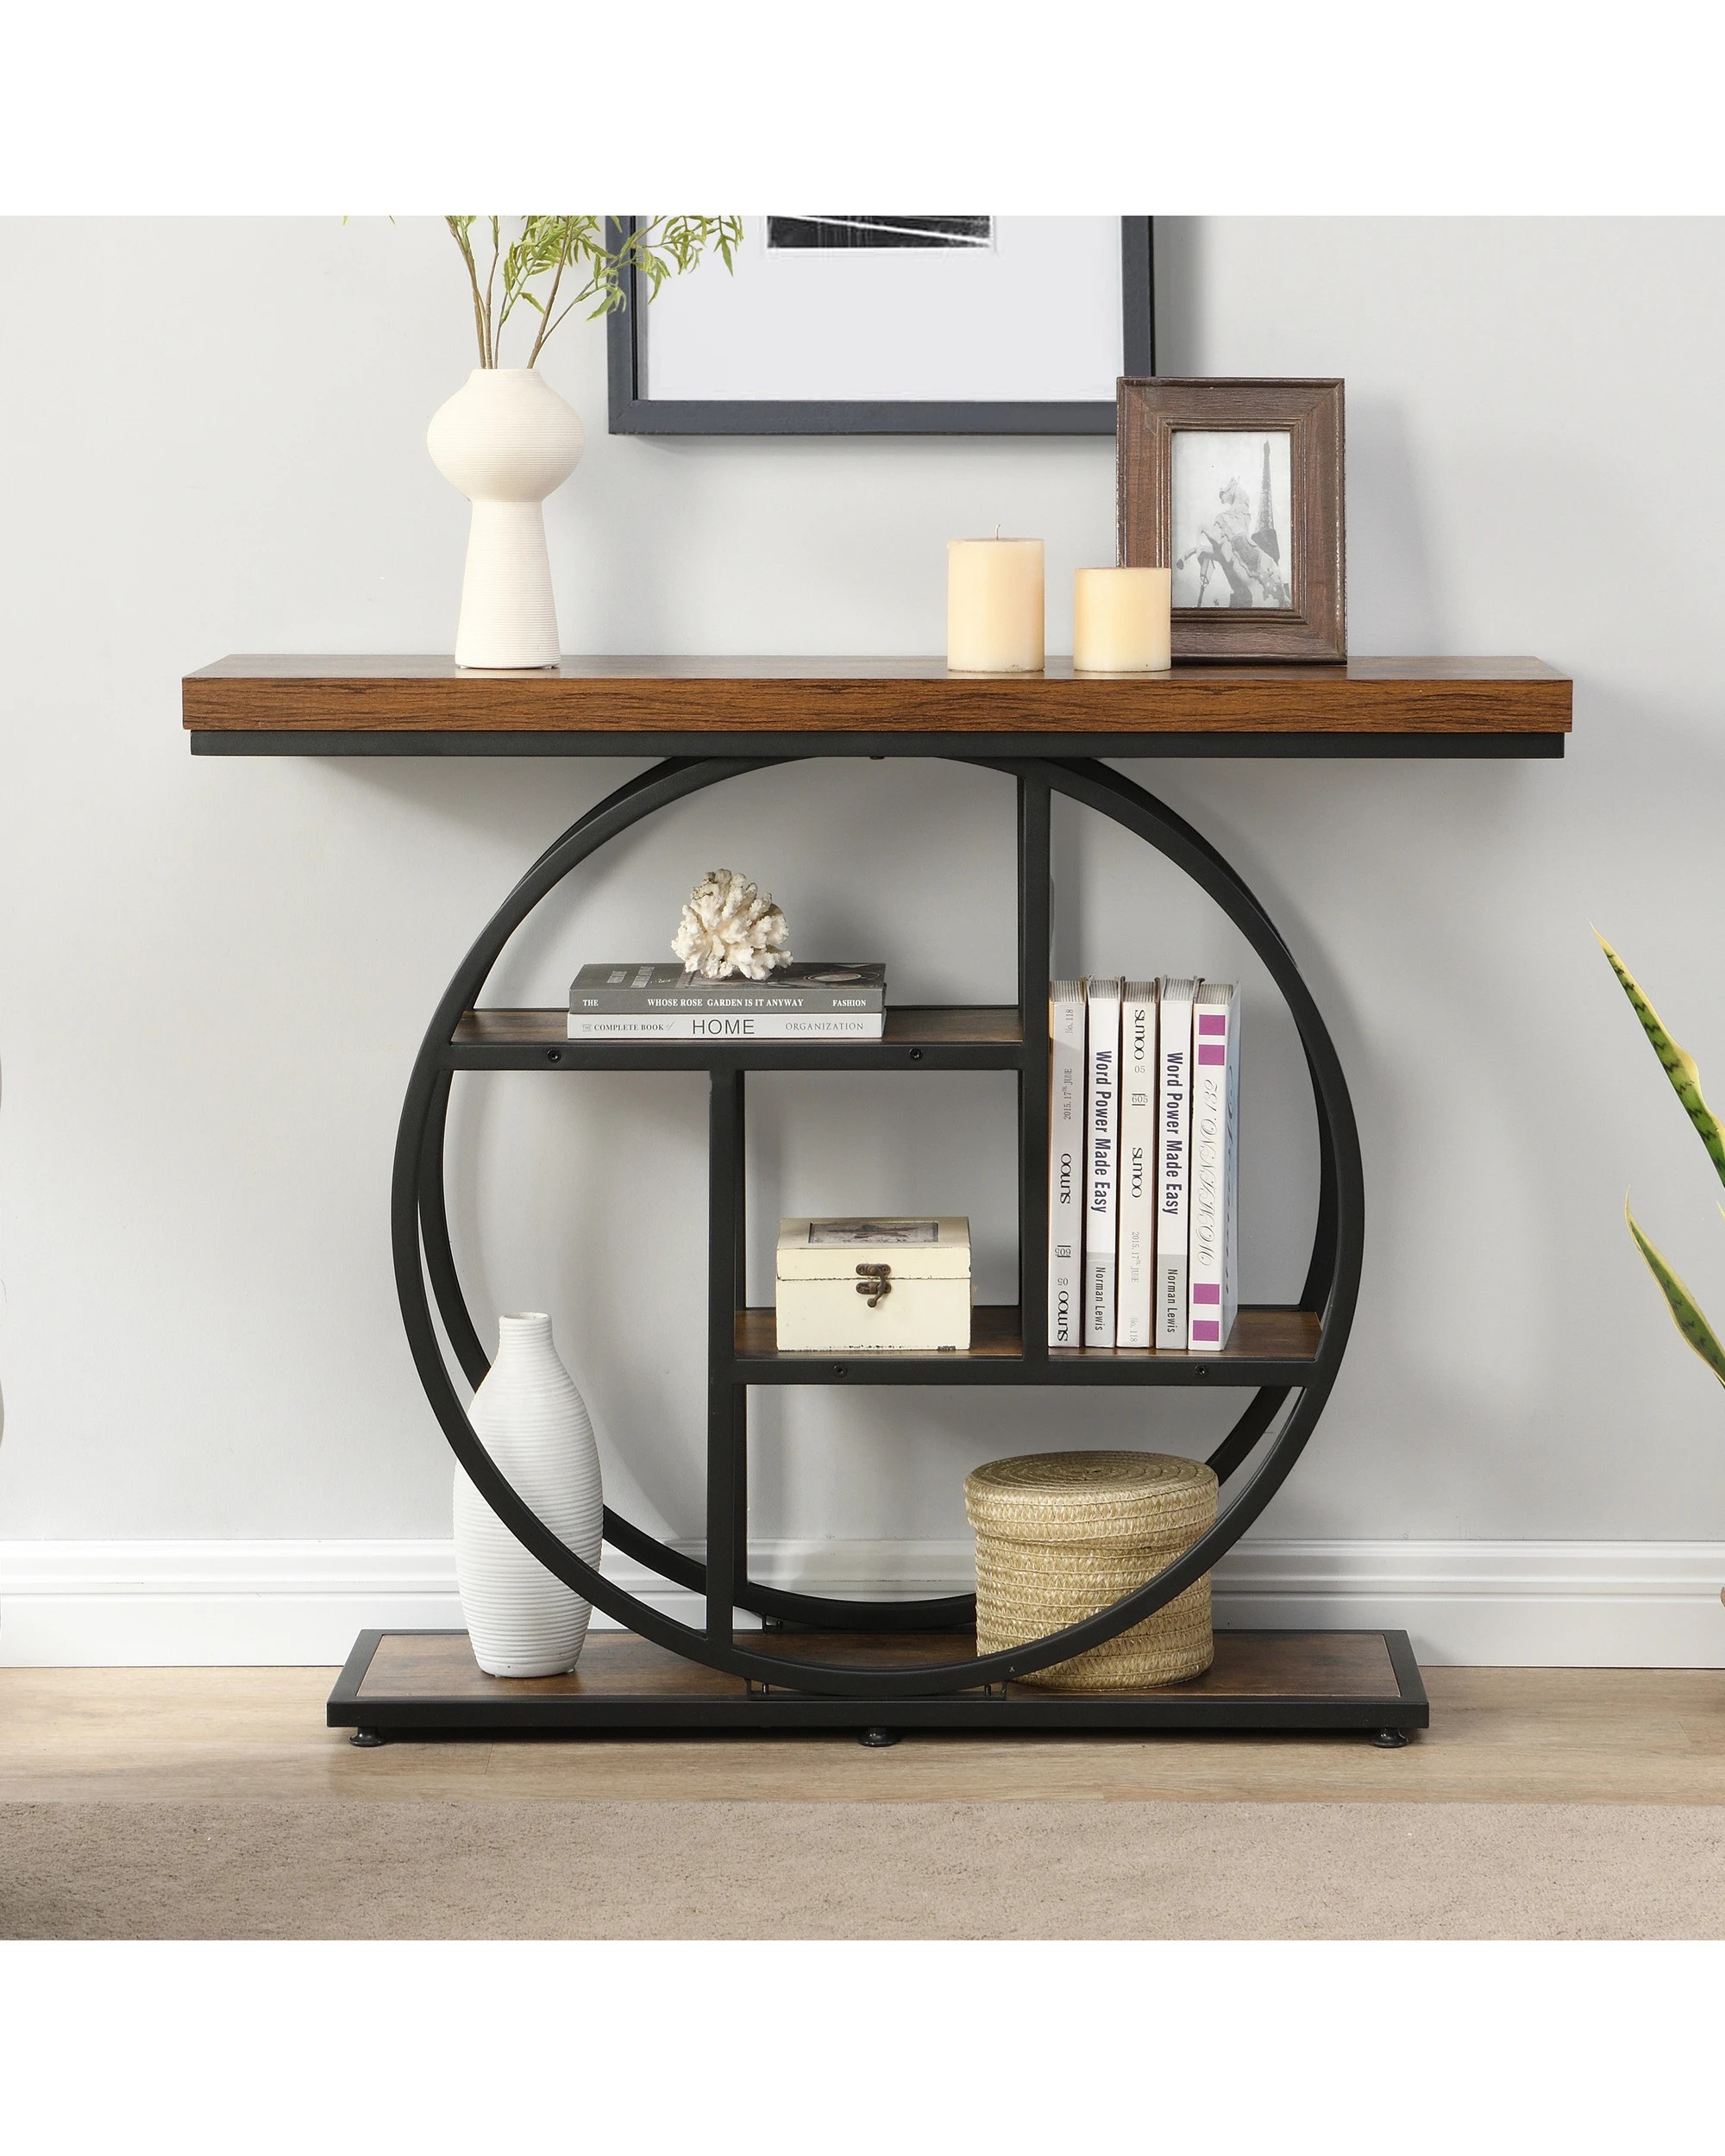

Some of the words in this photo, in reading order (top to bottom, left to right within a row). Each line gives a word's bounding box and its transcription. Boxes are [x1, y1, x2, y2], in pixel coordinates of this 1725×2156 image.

[647, 999, 679, 1007] WHOSE
[680, 999, 703, 1007] ROSE
[707, 999, 743, 1007] GARDEN
[744, 999, 753, 1007] IS
[755, 999, 764, 1007] IT
[766, 999, 804, 1007] ANYWAY
[832, 999, 867, 1007] FASHION
[692, 1019, 756, 1035] HOME
[785, 1022, 864, 1031] ORGANIZATION
[1095, 1050, 1113, 1085] Word
[1167, 1052, 1183, 1087] Word
[1095, 1091, 1112, 1133] Power
[1166, 1093, 1182, 1134] Power
[1095, 1138, 1112, 1175] Made
[1166, 1140, 1182, 1178] Made
[1091, 1181, 1111, 1213] Easy
[1163, 1183, 1182, 1215] Easy
[1095, 1267, 1106, 1302] Norman
[1167, 1269, 1178, 1304] Norman
[1095, 1305, 1105, 1331] Lewis
[1167, 1307, 1177, 1333] Lewis
